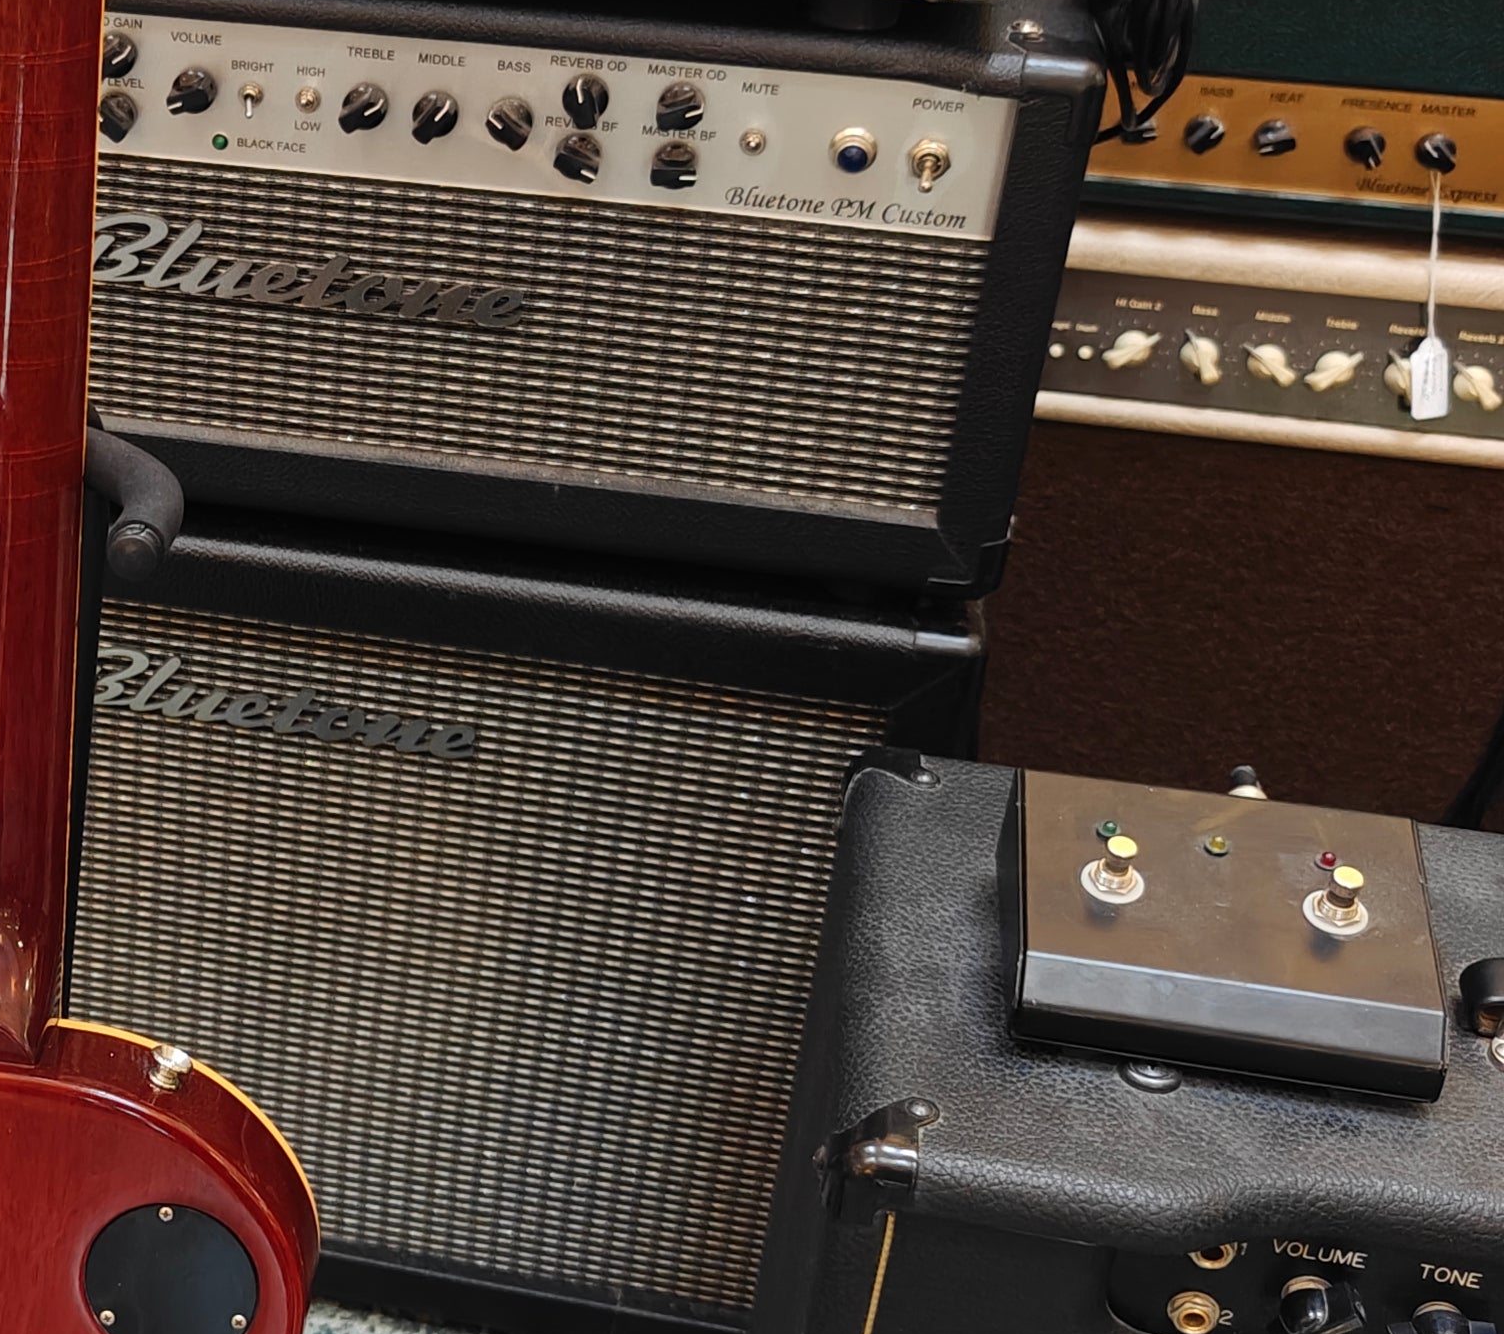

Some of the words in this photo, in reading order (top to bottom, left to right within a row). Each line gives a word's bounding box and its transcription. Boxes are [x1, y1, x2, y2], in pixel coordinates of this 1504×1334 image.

[113, 17, 143, 29] GAIN
[170, 31, 222, 46] VOLUME
[346, 46, 395, 62] TREBLE
[417, 52, 466, 68] MIDDLE
[231, 59, 275, 74] BRIGHT
[296, 64, 326, 78] HIGH
[497, 59, 532, 74] BASS
[550, 54, 603, 70] REVERB
[607, 59, 627, 72] OD
[647, 64, 702, 79] MASTER
[706, 69, 727, 81] OD
[108, 78, 144, 89] LEVEL
[741, 81, 780, 96] MUTE
[1200, 86, 1234, 99] BASS
[1269, 92, 1305, 104] HEAT
[912, 97, 964, 114] POWER
[1342, 98, 1412, 114] PRESENCE
[1420, 103, 1477, 118] MASTER
[294, 120, 321, 133] LOW
[545, 116, 597, 130] REV
[601, 121, 619, 133] BF
[642, 124, 695, 140] MASTER
[699, 130, 717, 142] BF
[236, 137, 274, 151] BLACK
[276, 140, 307, 153] FACE
[725, 185, 825, 216] Bluetone
[831, 198, 875, 221] PM
[882, 201, 967, 229] Custom
[94, 212, 524, 329] Bluetone
[1129, 298, 1153, 310] Gain
[95, 647, 475, 760] Bluetone
[1272, 1238, 1368, 1269] VOLUME
[1420, 1262, 1483, 1290] TONE
[1218, 1309, 1234, 1327] 2
